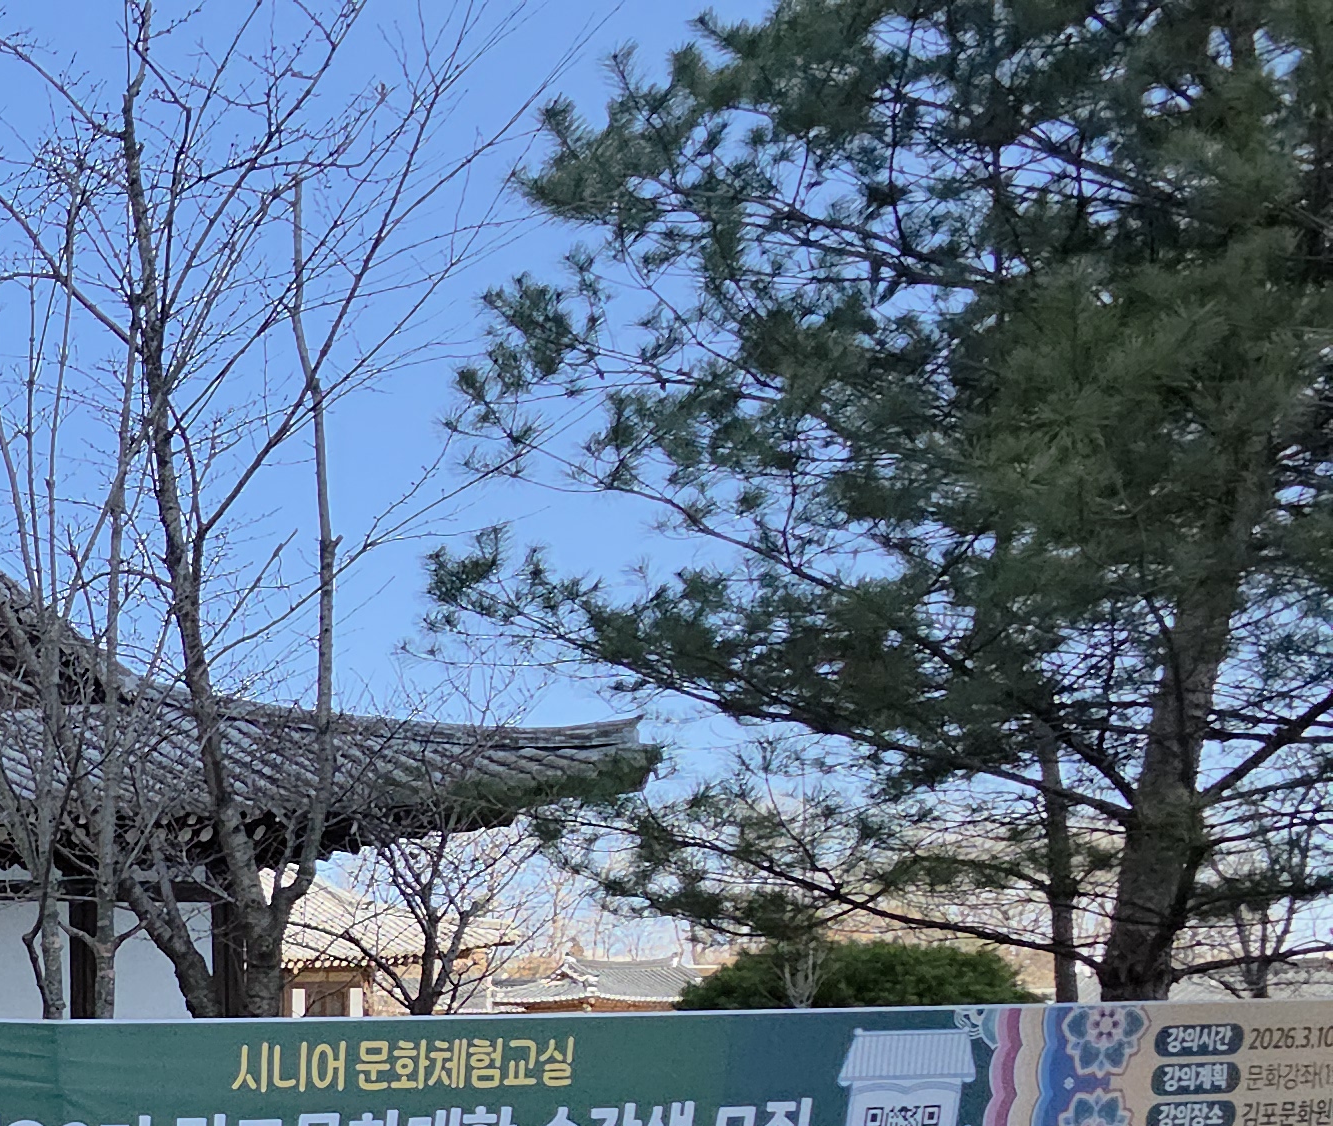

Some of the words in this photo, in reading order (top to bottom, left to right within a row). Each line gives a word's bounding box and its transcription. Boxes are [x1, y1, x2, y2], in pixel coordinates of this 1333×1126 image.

[1166, 1025, 1233, 1053] 강의시간
[231, 1041, 347, 1093] 시니어
[355, 1036, 575, 1091] 문화체험교실
[1162, 1064, 1228, 1092] 강의계획
